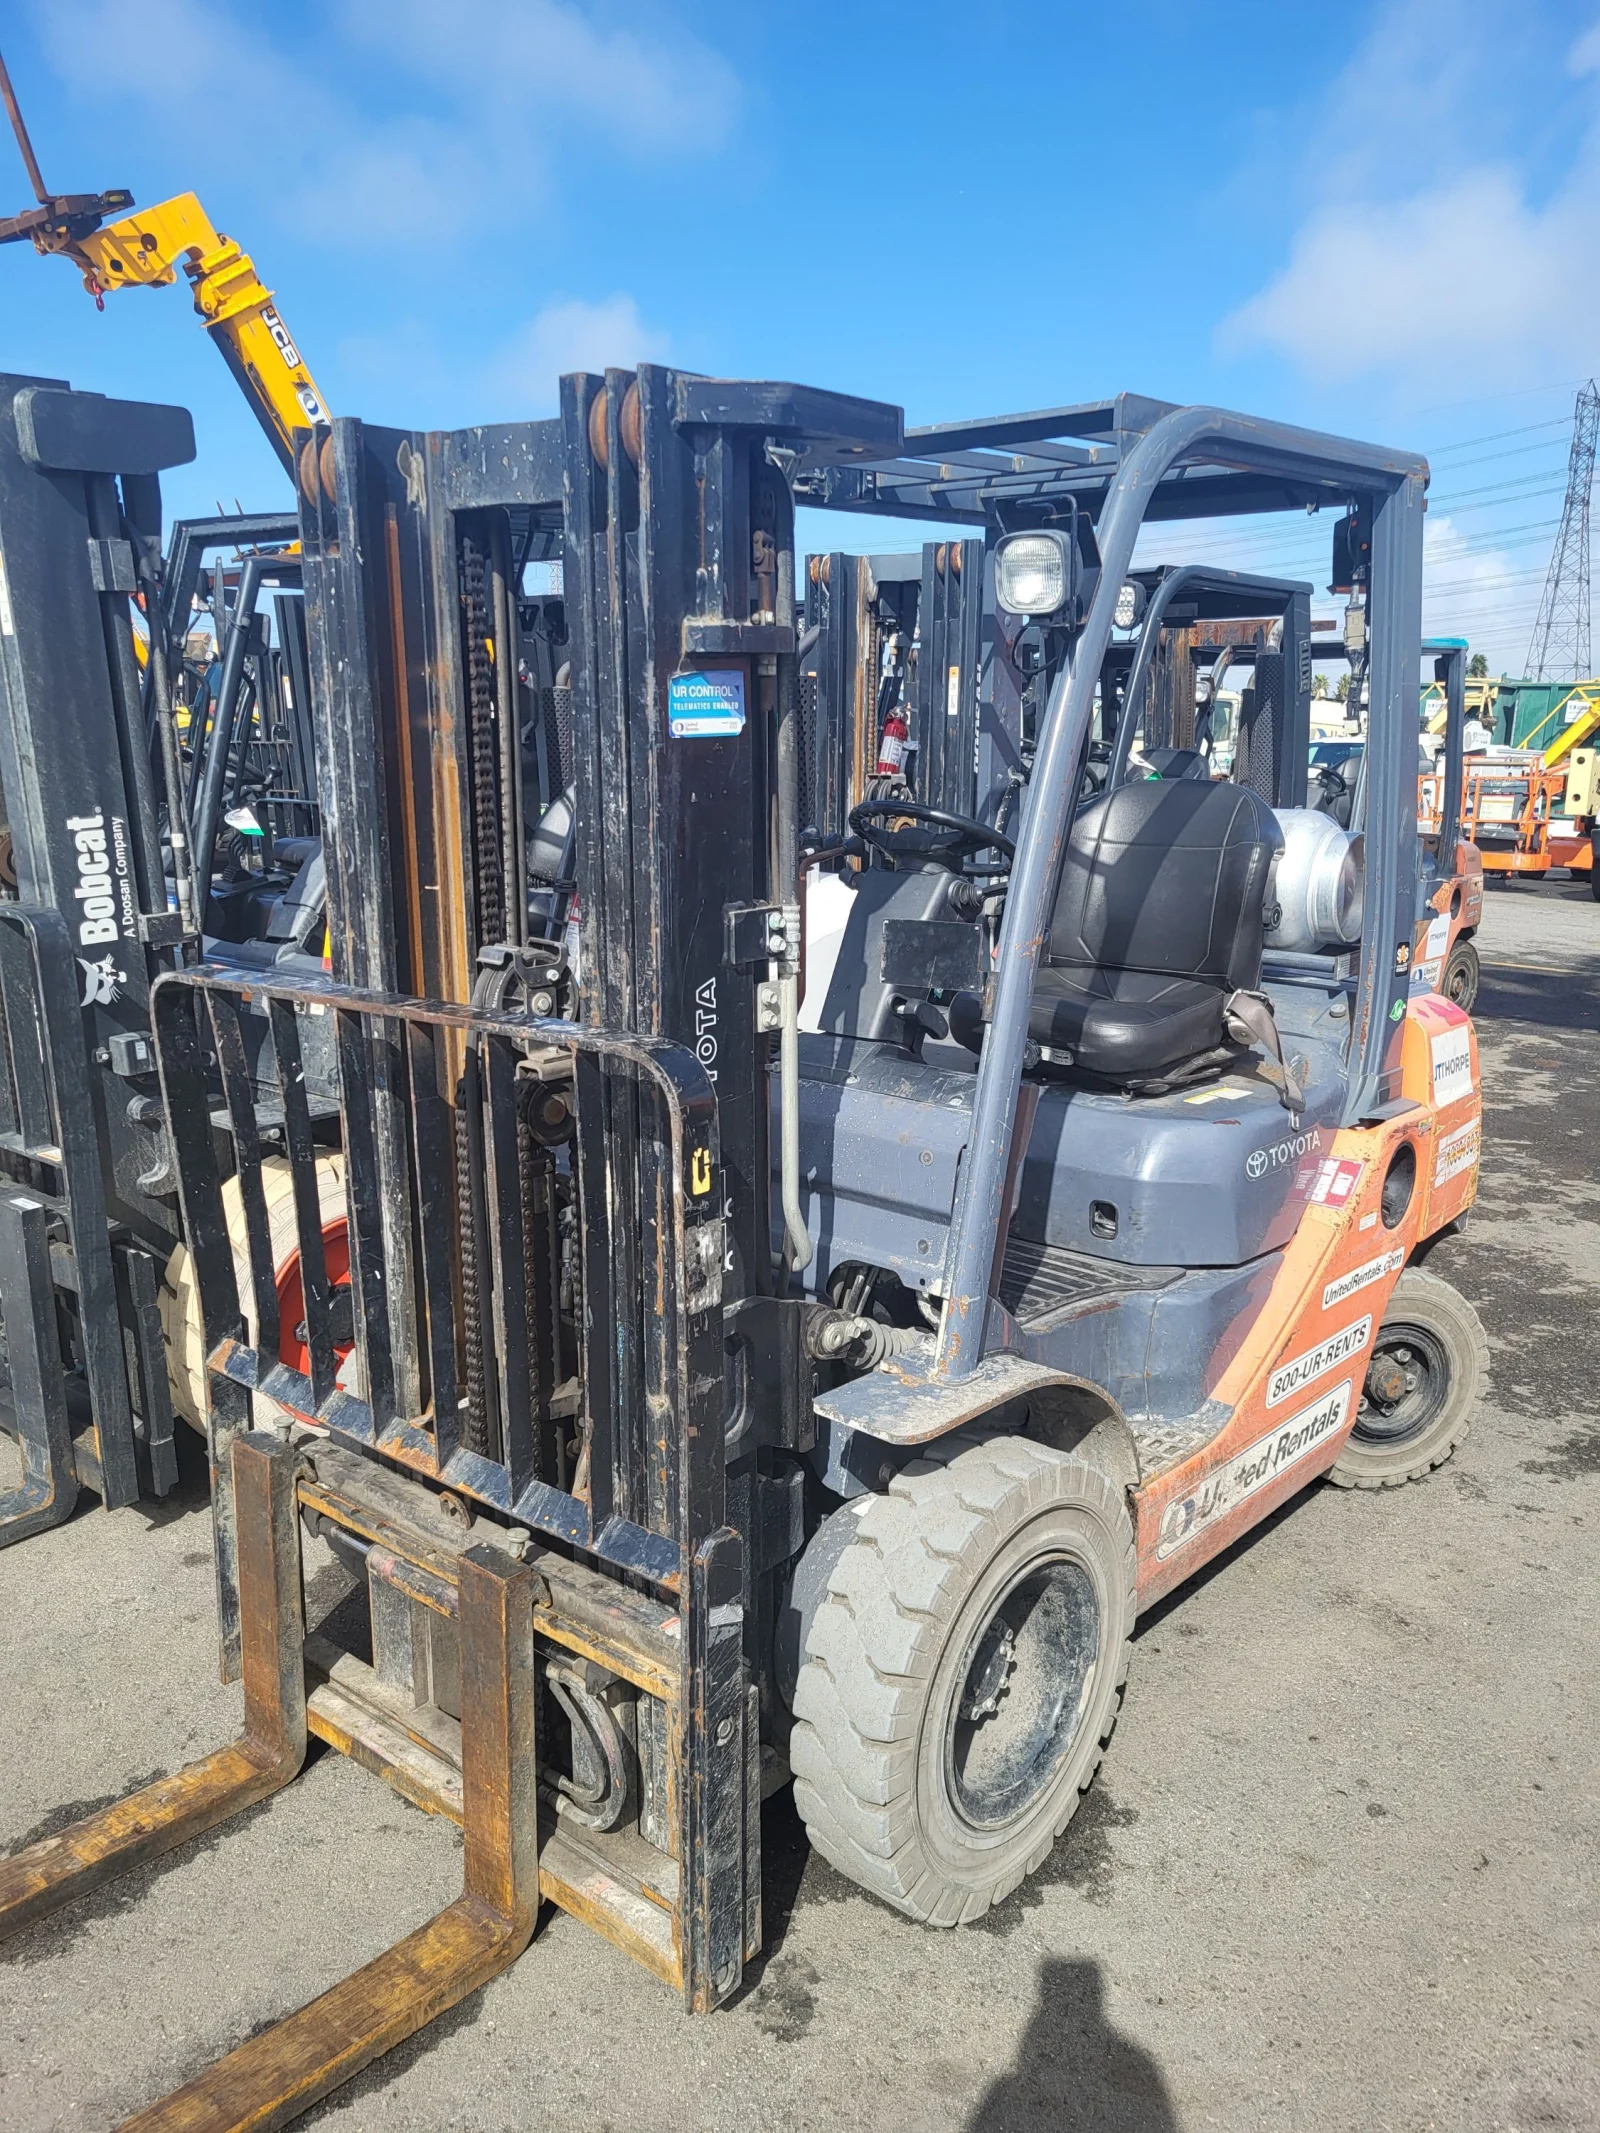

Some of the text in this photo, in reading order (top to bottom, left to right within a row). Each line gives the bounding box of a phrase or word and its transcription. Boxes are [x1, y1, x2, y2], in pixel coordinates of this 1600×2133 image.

[261, 308, 300, 369] JCB
[672, 684, 734, 698] UR CONTROL
[673, 701, 739, 711] TELEMATICS ENABLED
[111, 816, 136, 938] A Doosan Company
[1268, 1129, 1321, 1167] TOYOTA
[1324, 1253, 1402, 1305] UnitedRentals.com
[1272, 1323, 1367, 1398] 800-UR-RENTS
[1273, 1399, 1341, 1468] Rentals
